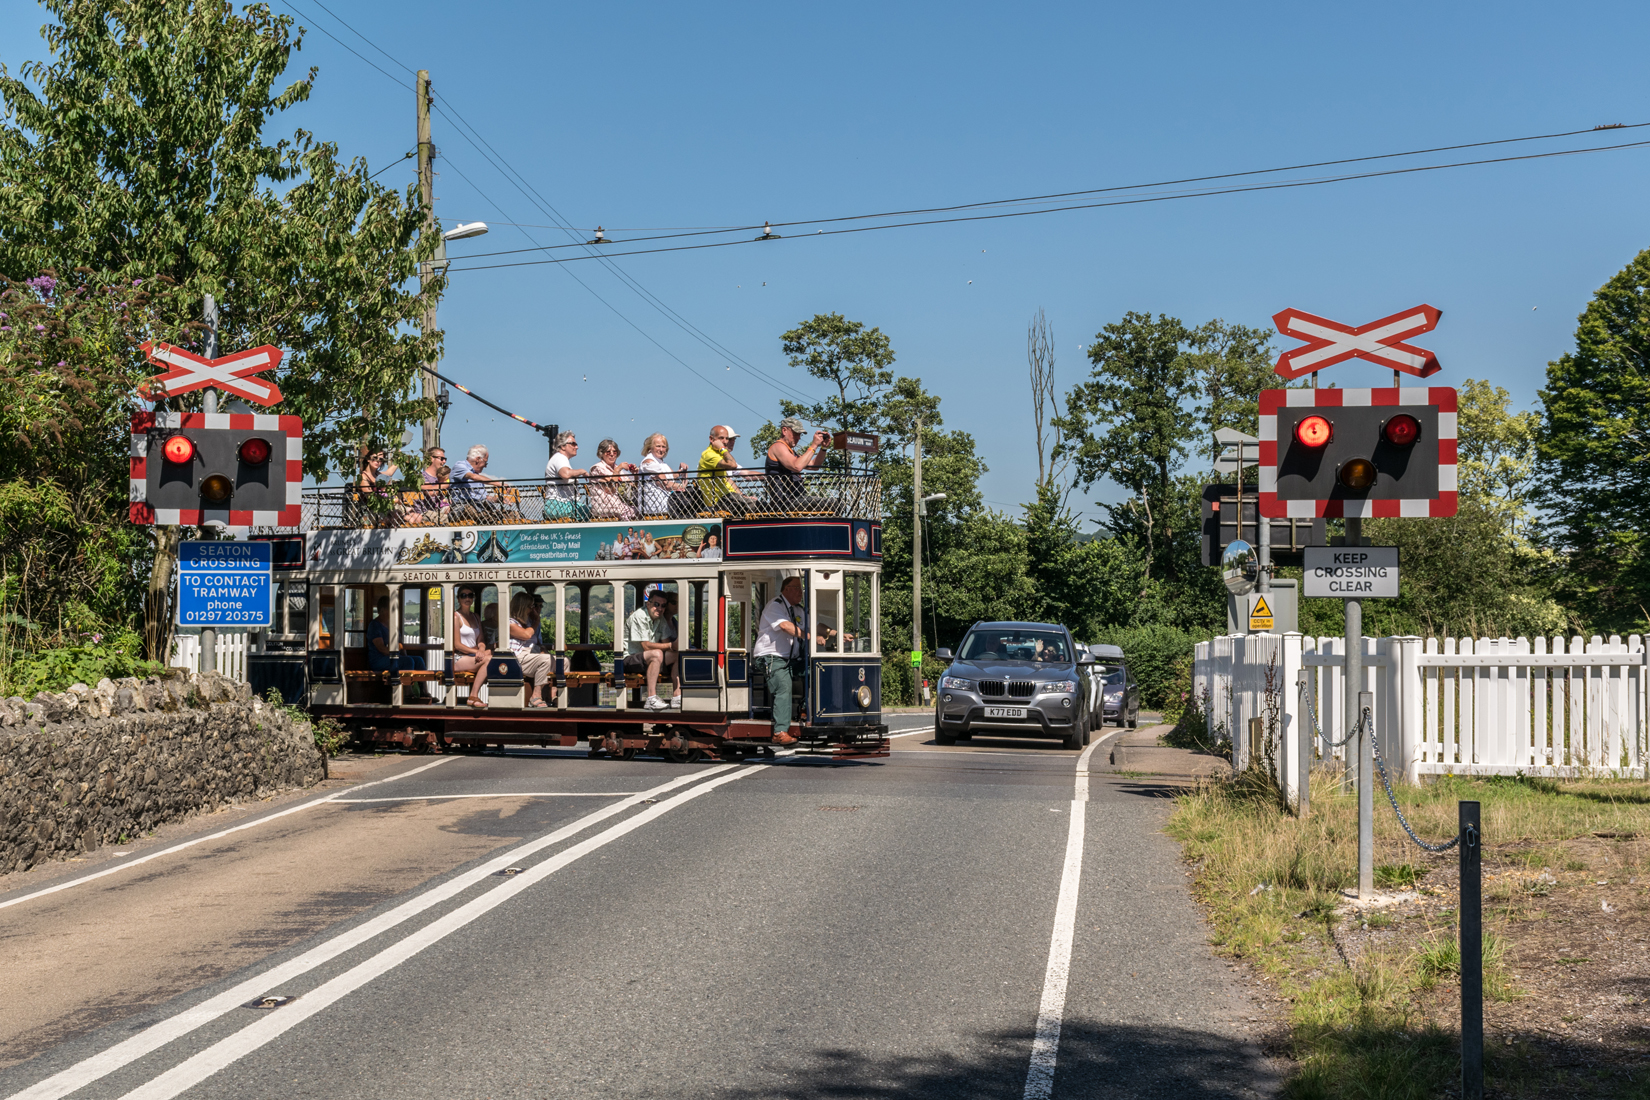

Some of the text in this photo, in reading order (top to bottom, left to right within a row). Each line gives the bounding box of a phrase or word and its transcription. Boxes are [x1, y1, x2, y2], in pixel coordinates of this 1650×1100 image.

[532, 533, 539, 541] of
[565, 532, 581, 541] finest
[552, 542, 567, 550] Daily
[568, 541, 581, 549] Mail
[199, 546, 251, 556] SEATON
[336, 547, 360, 556] GREAT
[529, 551, 579, 560] ssgreatbritain.org
[190, 557, 260, 568] CROSSING
[1333, 553, 1368, 564] KEEP
[403, 569, 607, 580] SEATON & DISTRICT ELECTRIC TRAMWAY
[1314, 566, 1387, 578] CROSSING
[184, 576, 266, 586] TO CONTACT
[1329, 581, 1373, 592] CLEAR
[192, 588, 257, 597] TRAMWAY
[207, 600, 242, 610] phone
[186, 611, 264, 621] 01297 20375
[858, 667, 865, 682] 8
